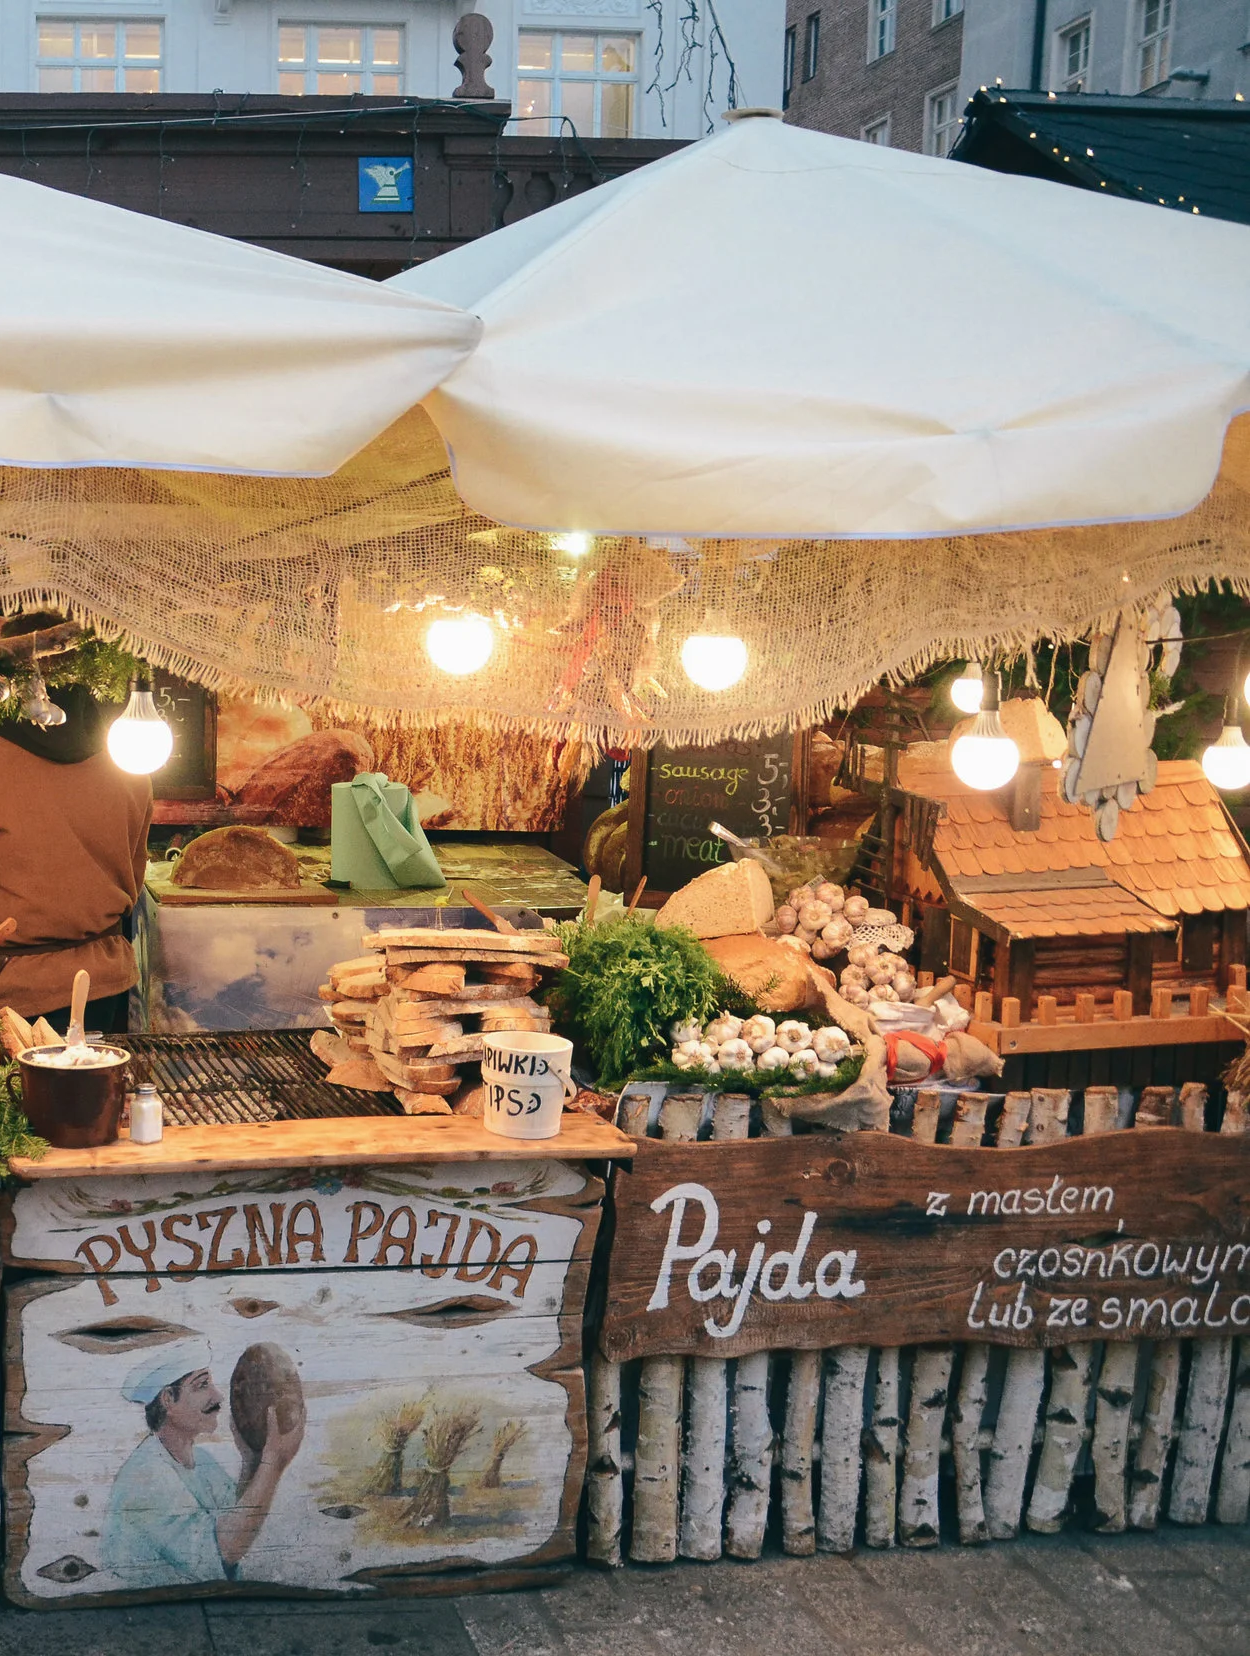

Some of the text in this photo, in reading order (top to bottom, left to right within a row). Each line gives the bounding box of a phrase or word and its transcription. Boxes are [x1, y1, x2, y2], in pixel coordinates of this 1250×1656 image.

[925, 1174, 1114, 1216] z masłem
[74, 1200, 540, 1307] PYSZNA PAJDA
[646, 1182, 866, 1338] Pajda
[967, 1280, 1034, 1330] lub
[1046, 1297, 1089, 1327] ze
